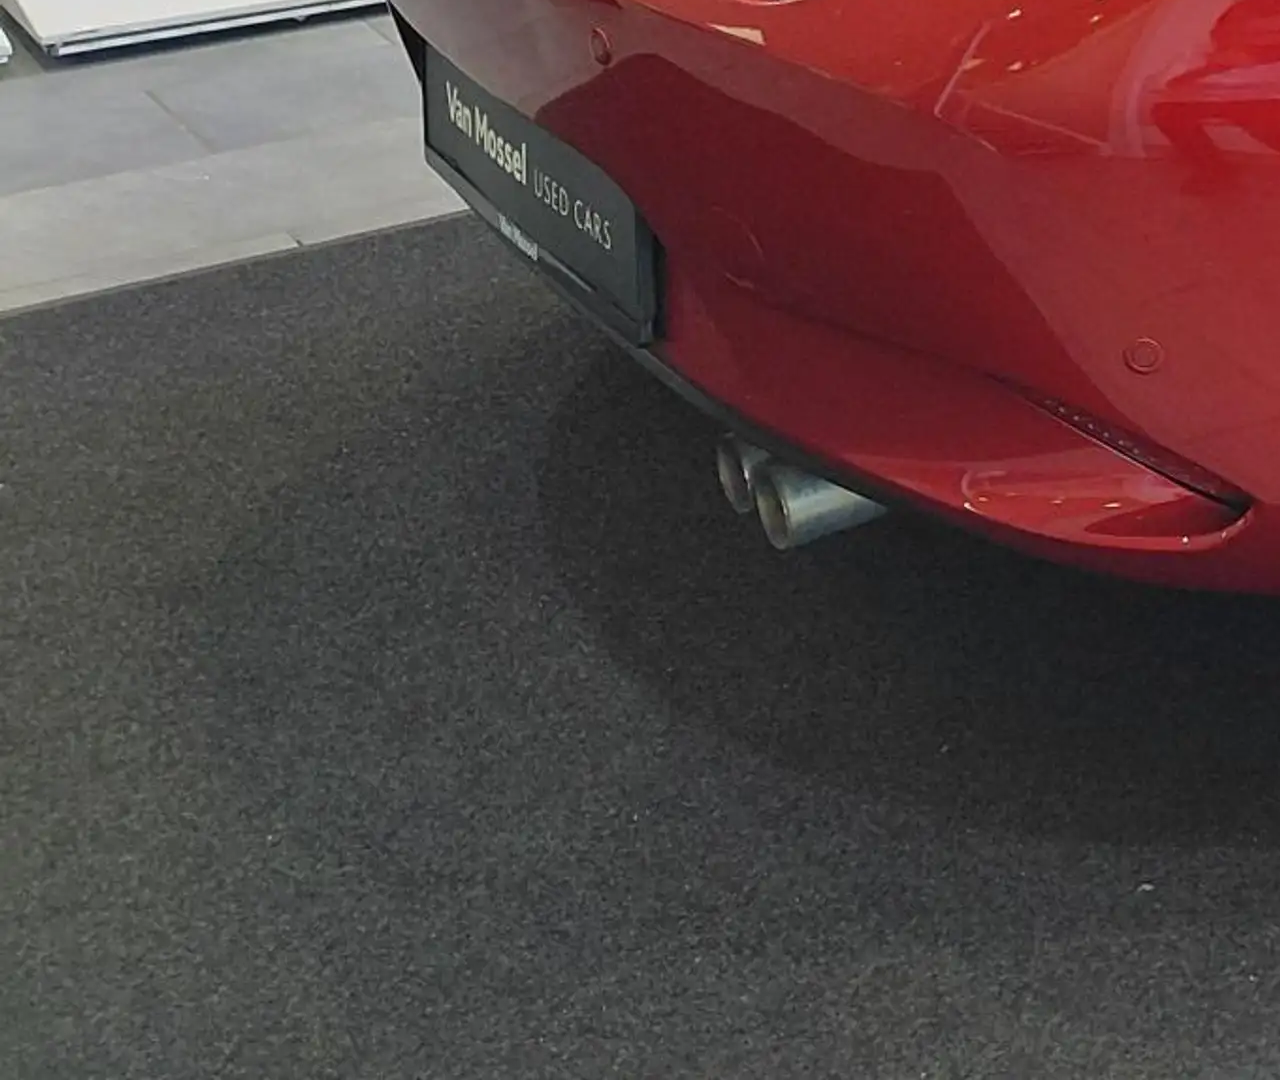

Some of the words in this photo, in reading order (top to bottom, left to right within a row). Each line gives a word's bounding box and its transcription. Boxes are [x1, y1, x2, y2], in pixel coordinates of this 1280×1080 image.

[446, 80, 472, 138] Van
[474, 105, 526, 185] Mossel
[533, 169, 570, 216] USED
[574, 199, 612, 250] CARS
